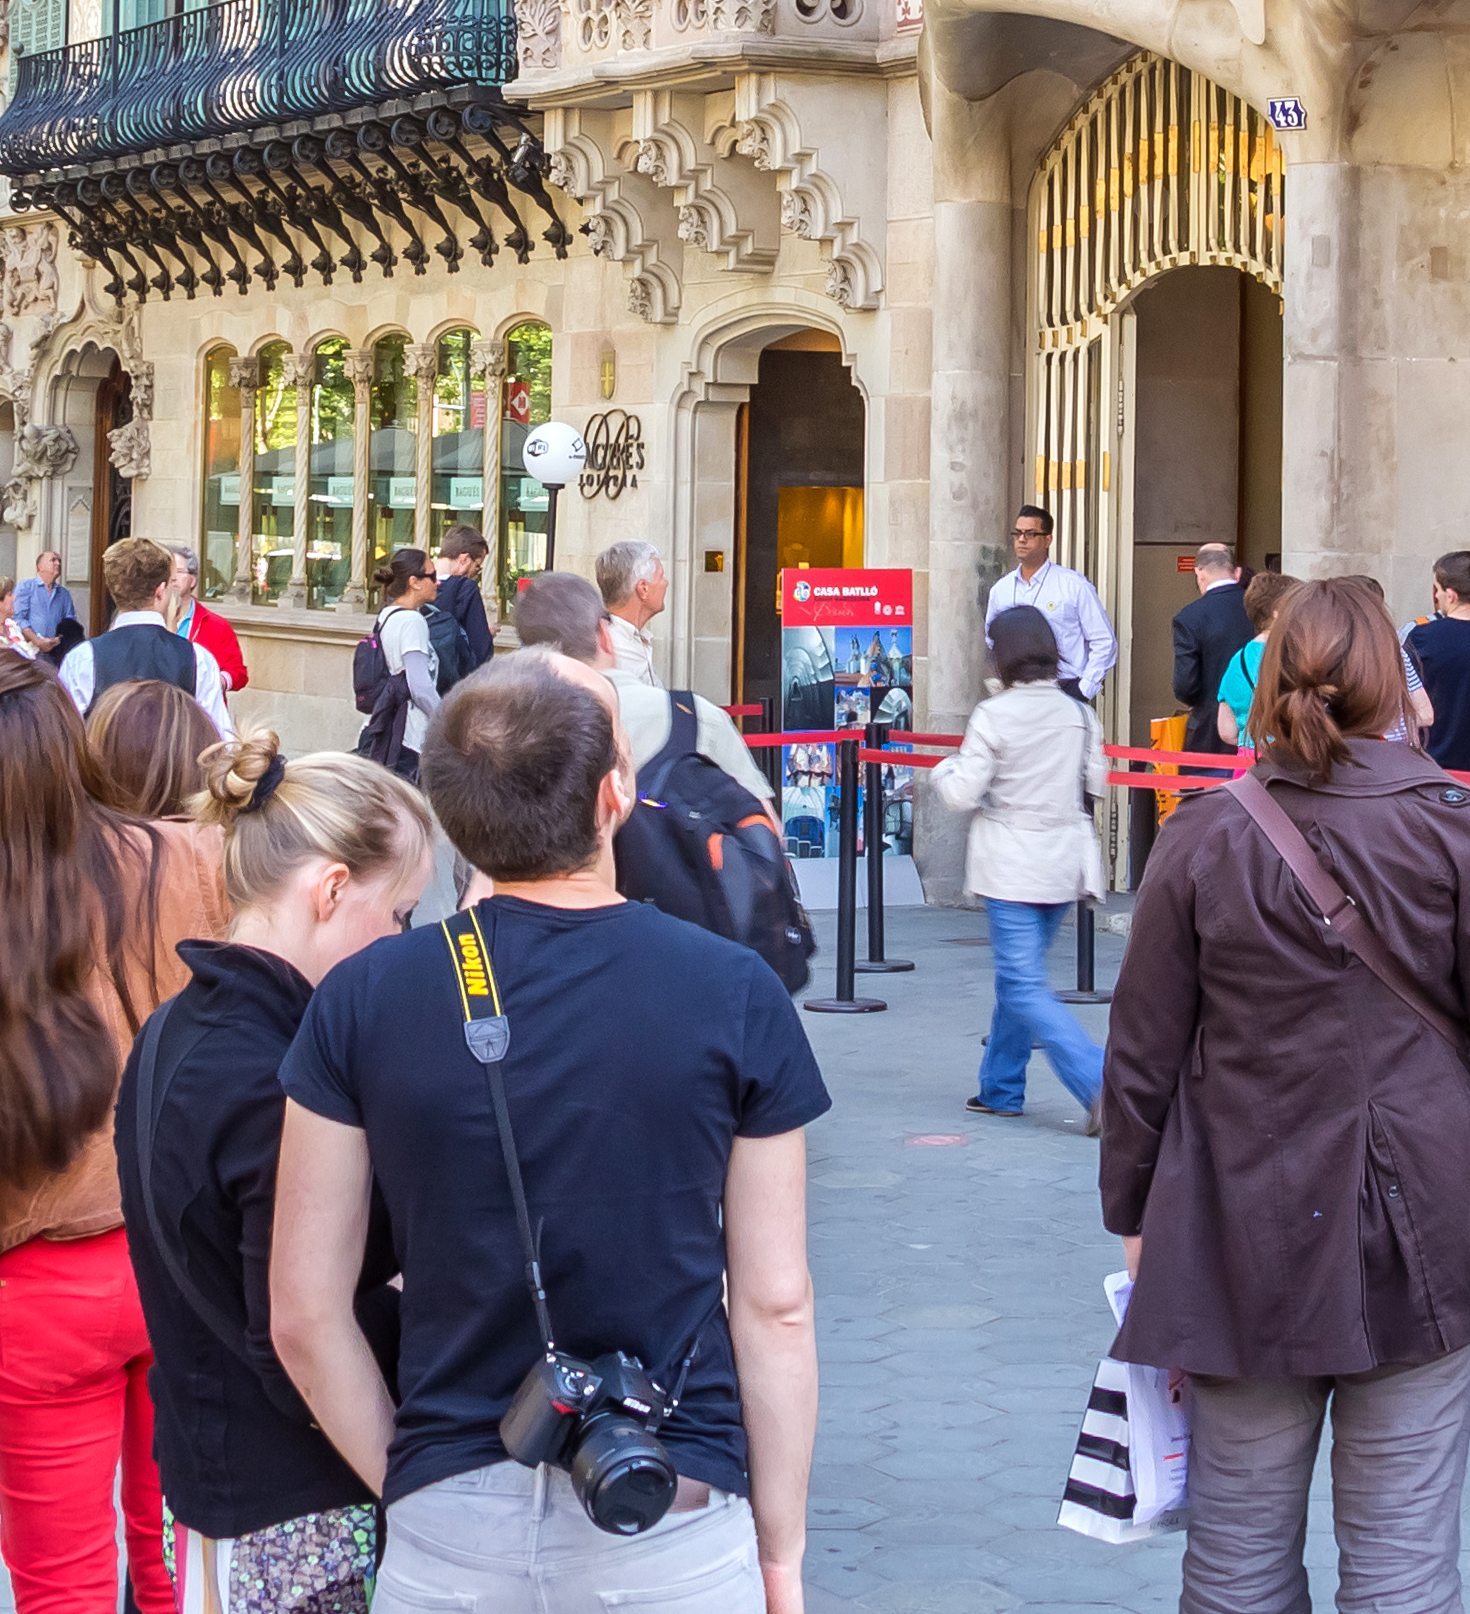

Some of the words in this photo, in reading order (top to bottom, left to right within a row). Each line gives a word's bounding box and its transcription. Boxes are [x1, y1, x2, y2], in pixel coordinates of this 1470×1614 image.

[1274, 100, 1298, 127] 43
[813, 587, 841, 597] CASA
[842, 585, 879, 597] BATLLÓ
[458, 933, 489, 996] Nikon
